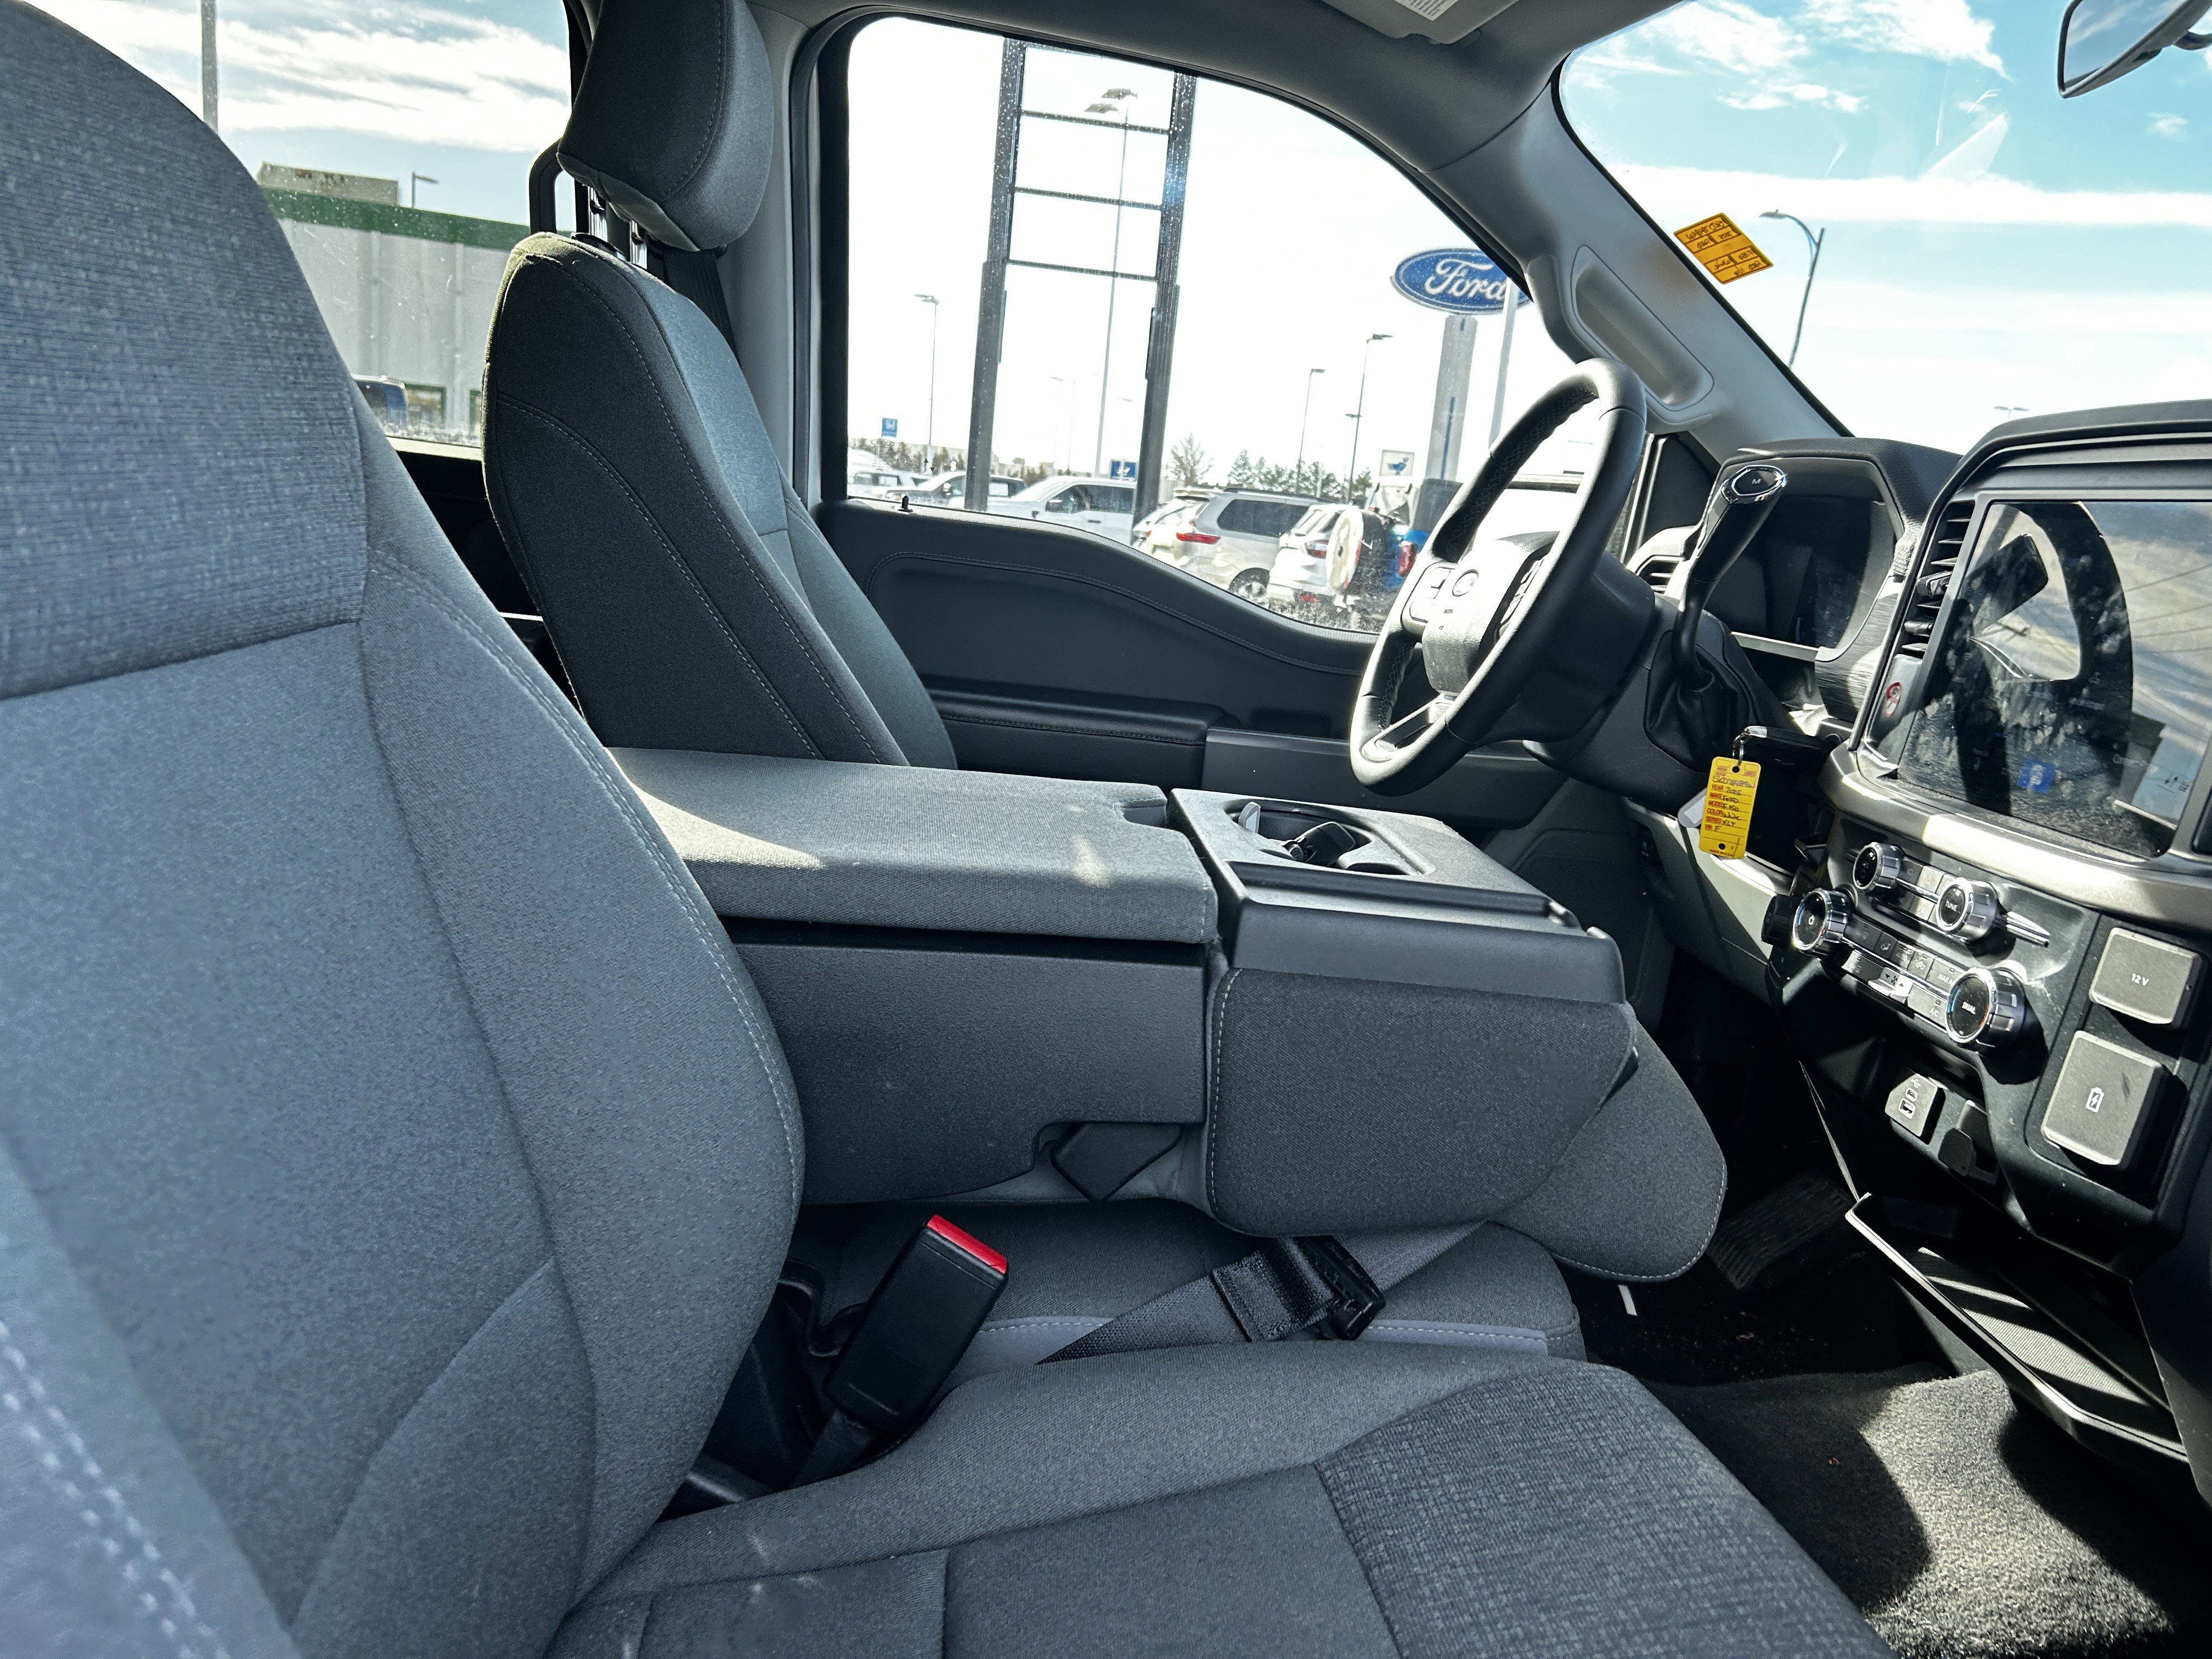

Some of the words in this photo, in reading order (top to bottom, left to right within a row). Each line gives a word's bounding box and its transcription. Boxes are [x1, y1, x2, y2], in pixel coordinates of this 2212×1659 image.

[1424, 258, 1508, 300] Ford
[1945, 900, 1958, 912] TUNE
[1938, 973, 1950, 983] MAX
[1929, 1008, 1939, 1017] A/C
[1962, 1002, 1976, 1015] DUAL
